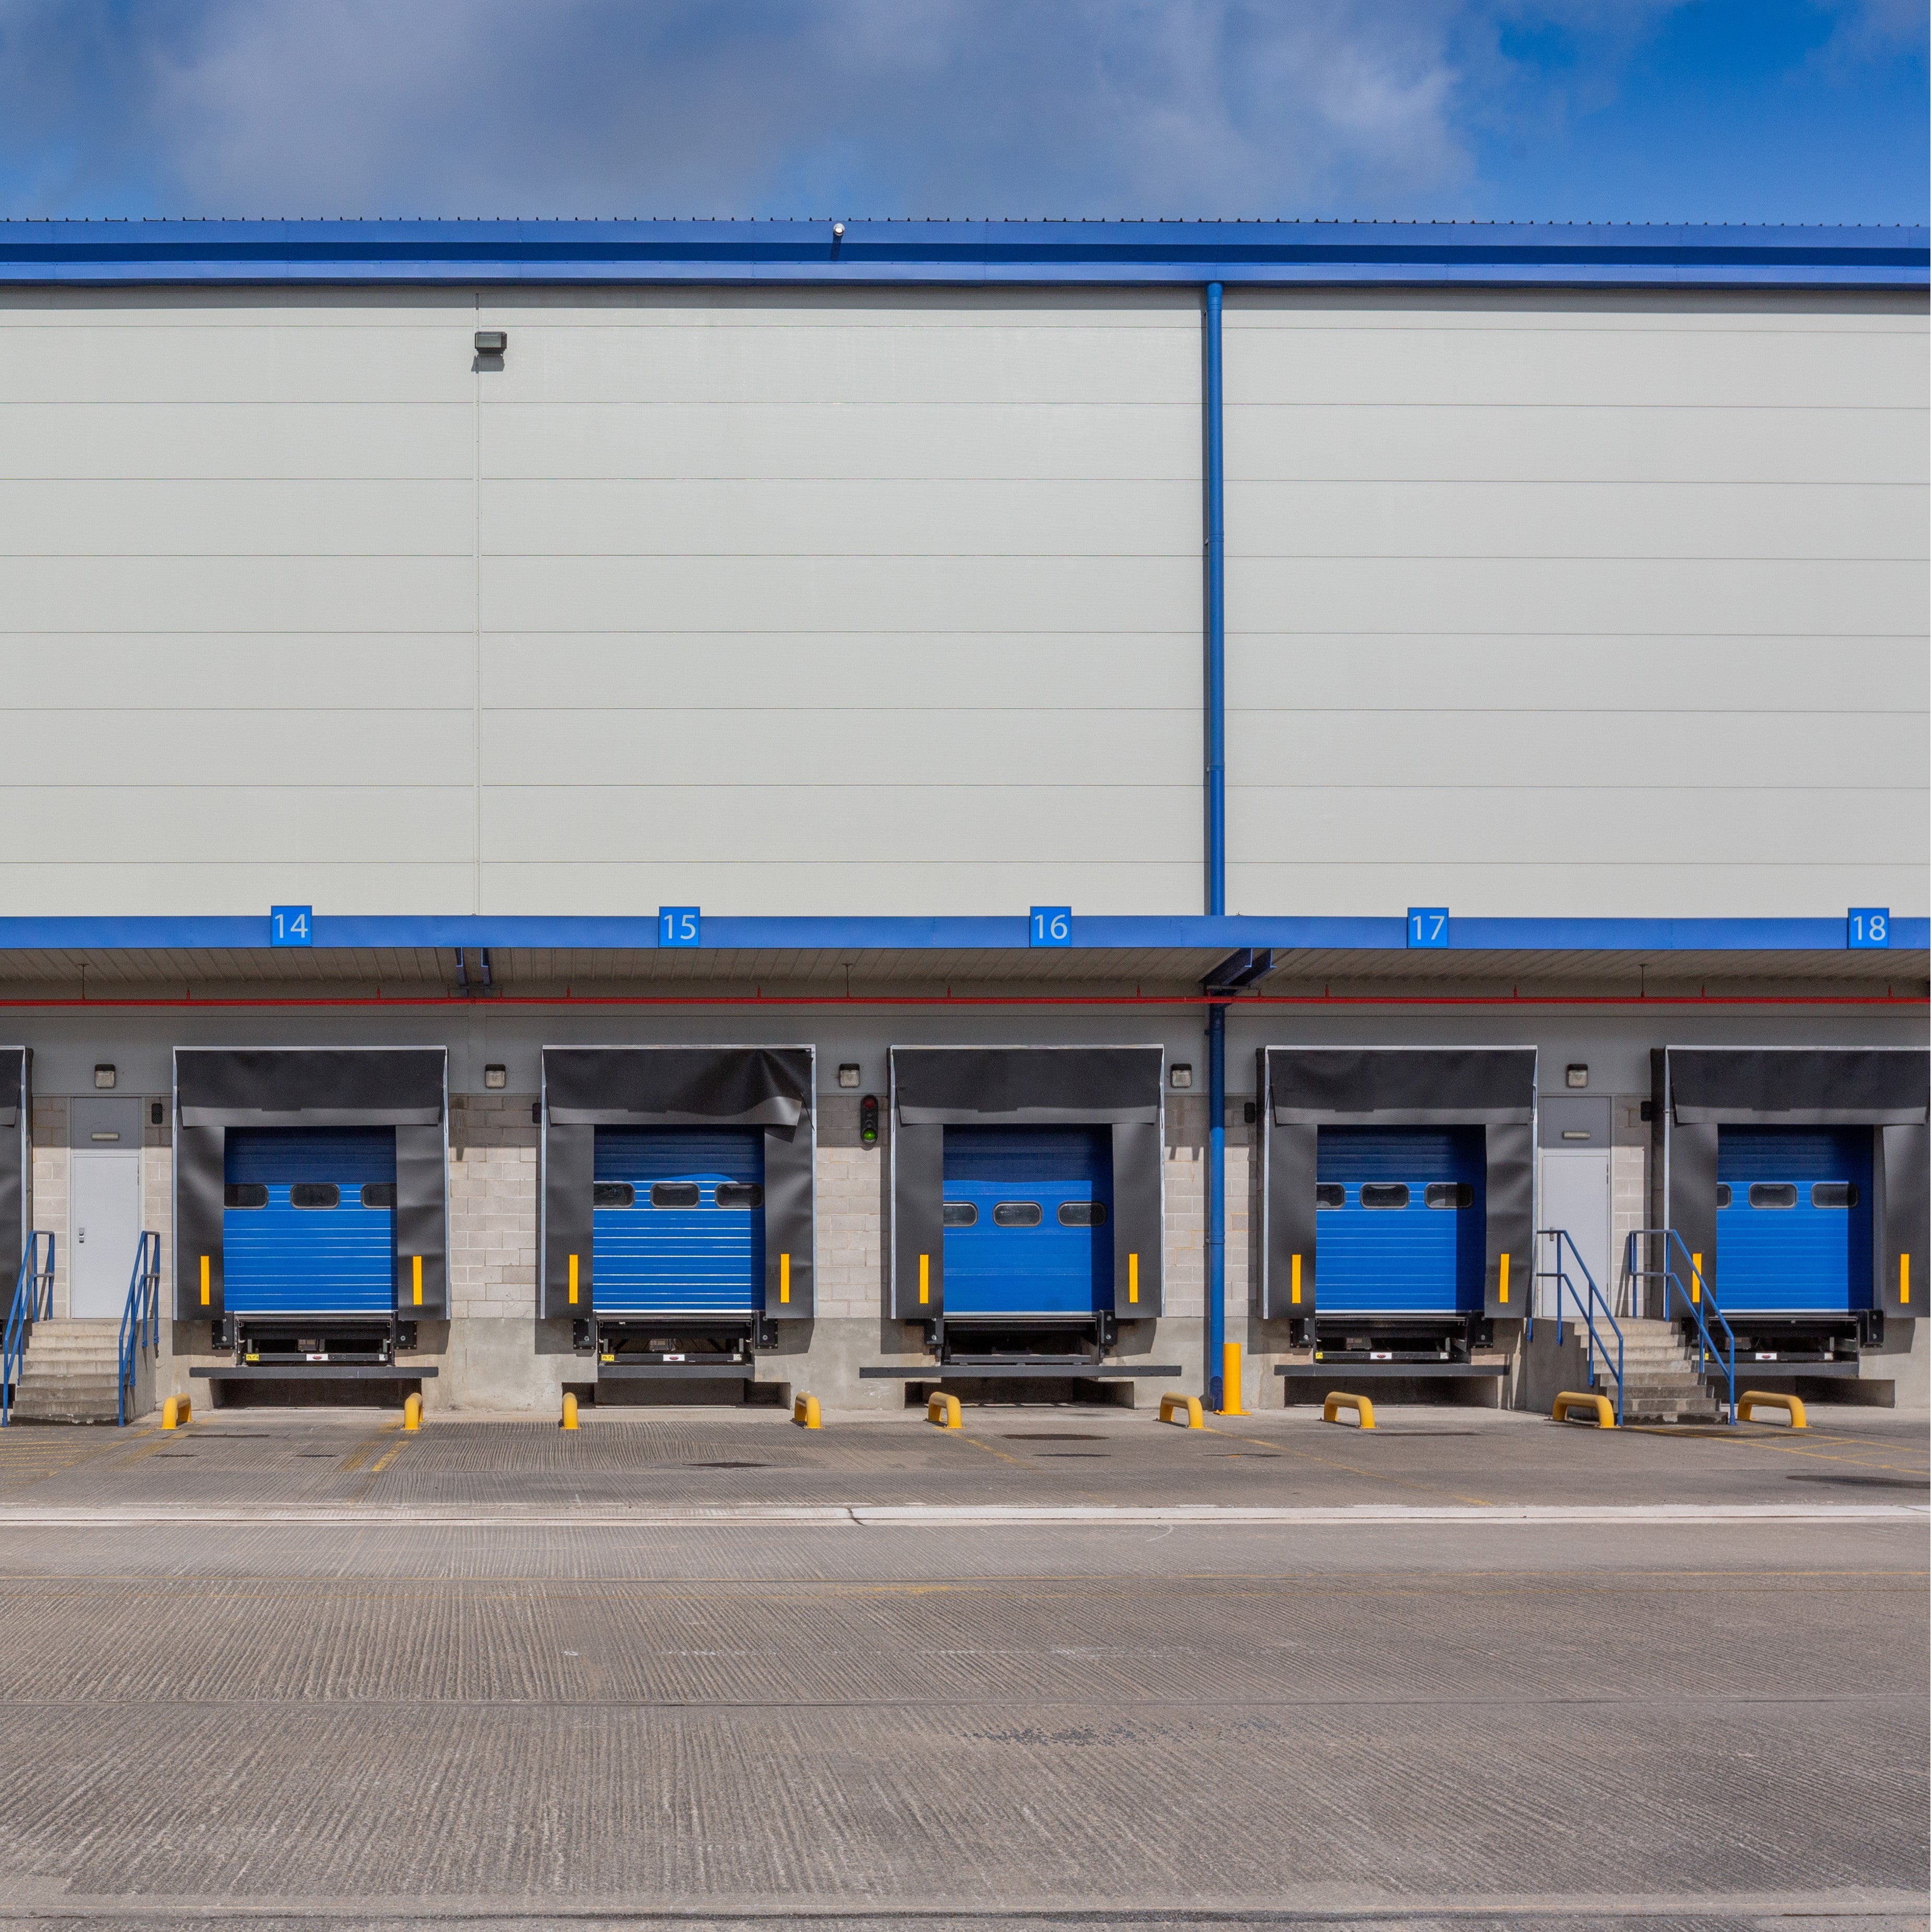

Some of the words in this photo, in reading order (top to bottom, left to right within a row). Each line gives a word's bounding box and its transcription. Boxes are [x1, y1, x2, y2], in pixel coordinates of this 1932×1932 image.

[275, 914, 308, 938] 14
[664, 915, 695, 939] 15
[1035, 915, 1067, 939] 16
[1413, 916, 1445, 940] 17
[1854, 916, 1886, 940] 18
